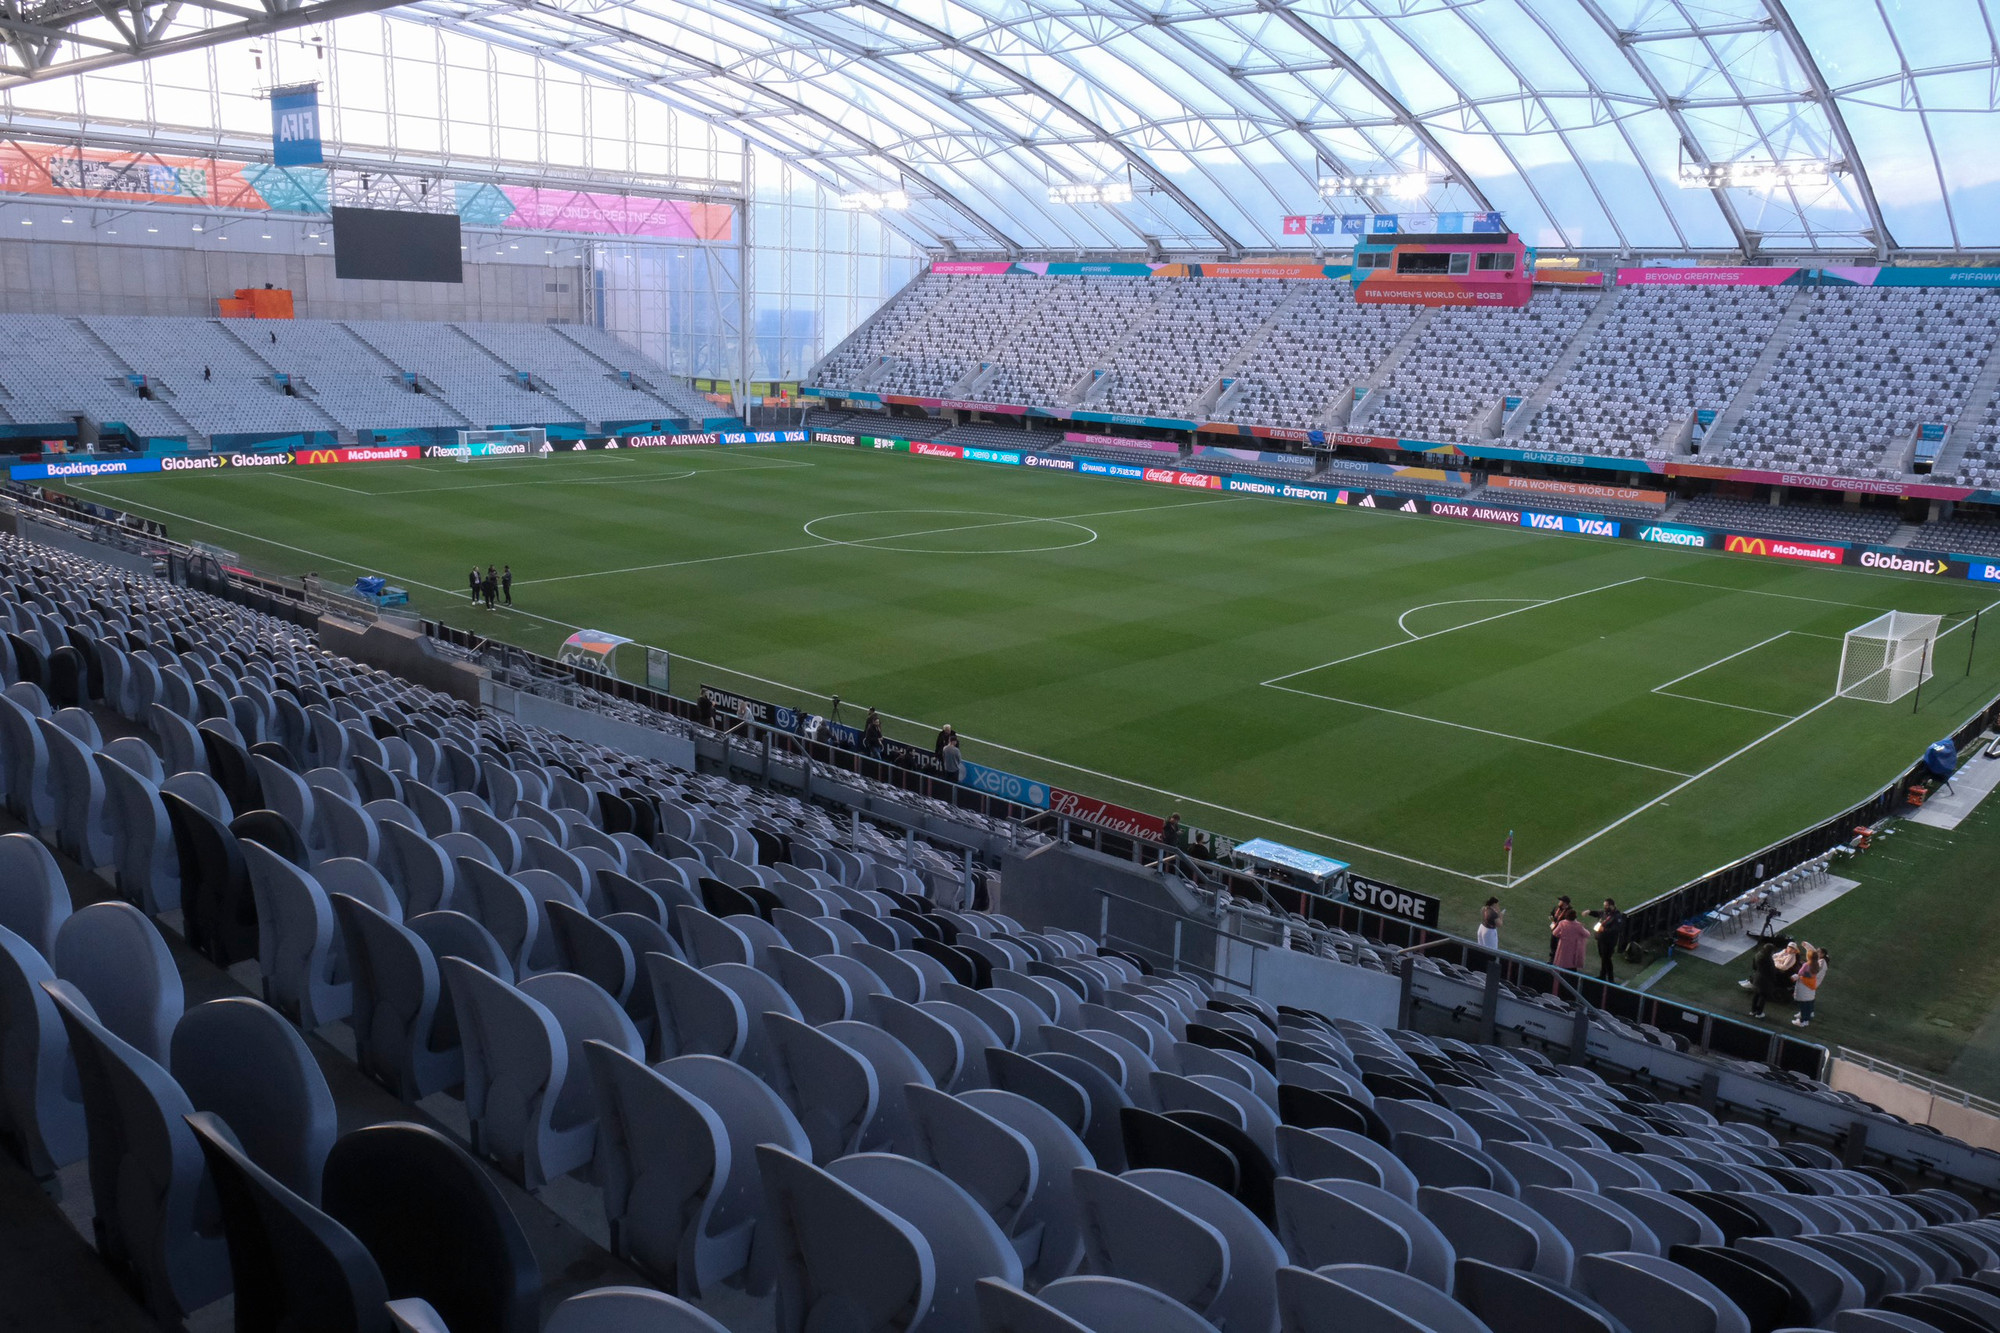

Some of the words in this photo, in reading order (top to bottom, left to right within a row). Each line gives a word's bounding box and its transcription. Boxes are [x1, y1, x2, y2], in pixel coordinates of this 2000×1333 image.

[1377, 220, 1394, 228] FIFA
[1645, 273, 1682, 281] BEYOND
[1684, 273, 1740, 281] GREATNESS
[1383, 290, 1422, 298] WOMEN'S
[1424, 291, 1454, 299] WORLD
[1476, 292, 1503, 300] 2023
[941, 400, 963, 408] BEYOND
[964, 402, 997, 410] GREATNESS
[631, 435, 667, 447] QATAR
[671, 433, 717, 446] AIRWAYS
[723, 434, 746, 444] VISA
[753, 432, 776, 443] VISA
[783, 431, 805, 442] VISA
[815, 433, 832, 443] FIFA
[833, 434, 855, 445] STORE
[1086, 435, 1112, 444] BEYOND
[1113, 438, 1153, 449] GREATNESS
[1270, 429, 1285, 437] FIFA
[1355, 436, 1372, 445] CUP
[348, 448, 408, 461] McDonald's
[433, 445, 471, 457] Rexona
[488, 442, 525, 454] Rexona
[917, 443, 957, 458] Budweiser
[161, 456, 219, 471] Globant
[231, 453, 287, 467] Globant
[1039, 458, 1074, 470] HYUNDAI
[1277, 455, 1314, 466] DUNEDIN
[47, 461, 127, 476] Booking.com
[1088, 464, 1107, 473] WANDA
[1229, 481, 1275, 495] DUNEDIN
[1508, 478, 1528, 488] FIFA
[1530, 480, 1576, 493] WOMEN'S
[1578, 485, 1615, 497] WORLD
[1617, 488, 1639, 499] CUP
[1782, 474, 1829, 487] BEYOND
[1831, 479, 1903, 493] GREATNESS
[1433, 503, 1469, 517] QATAR
[1472, 508, 1519, 523] AIRWAYS
[1528, 513, 1564, 530] VISA
[1576, 519, 1613, 537] VISA
[1651, 527, 1705, 547] Rexona
[1773, 544, 1836, 560] McDonald's
[1860, 551, 1935, 574] Globant
[973, 766, 1022, 798] xero
[1050, 791, 1163, 842] Budweiser
[1353, 881, 1427, 920] STORE
